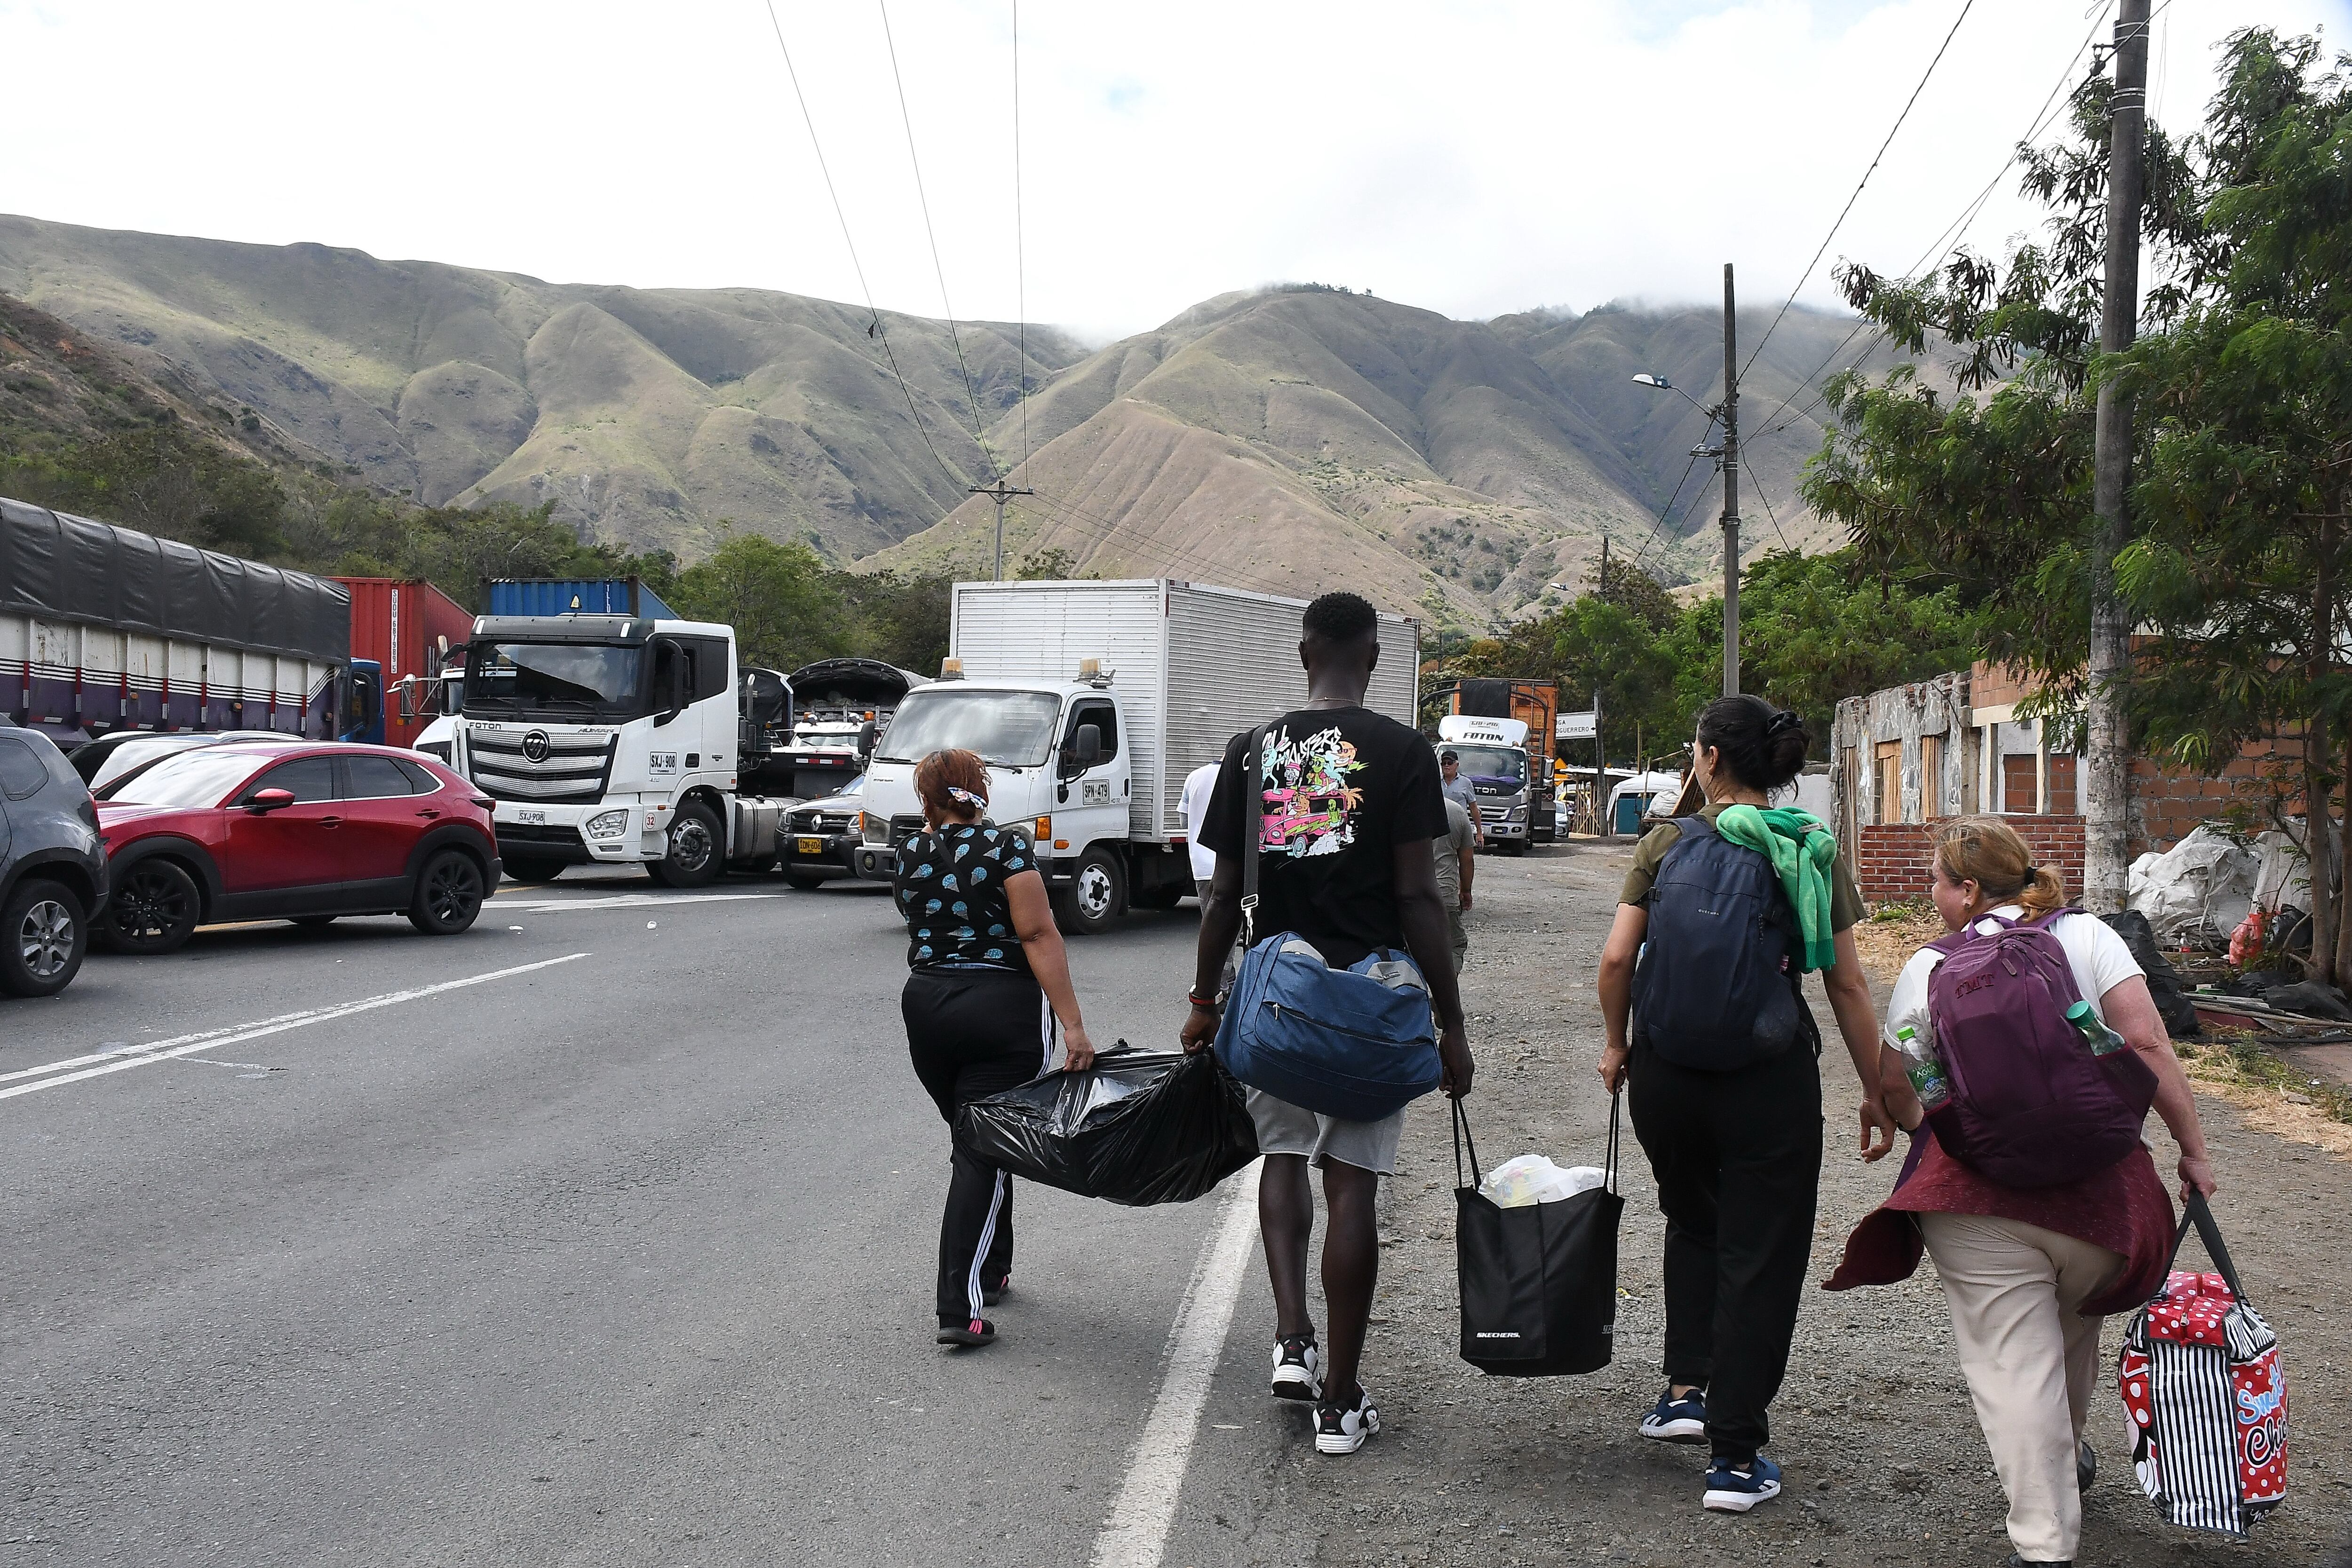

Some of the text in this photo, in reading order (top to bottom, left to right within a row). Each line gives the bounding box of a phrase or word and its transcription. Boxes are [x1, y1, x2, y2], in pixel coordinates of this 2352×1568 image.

[1463, 732, 1504, 741] FOTON
[647, 817, 654, 825] 32
[1917, 1066, 1937, 1078] AGUA
